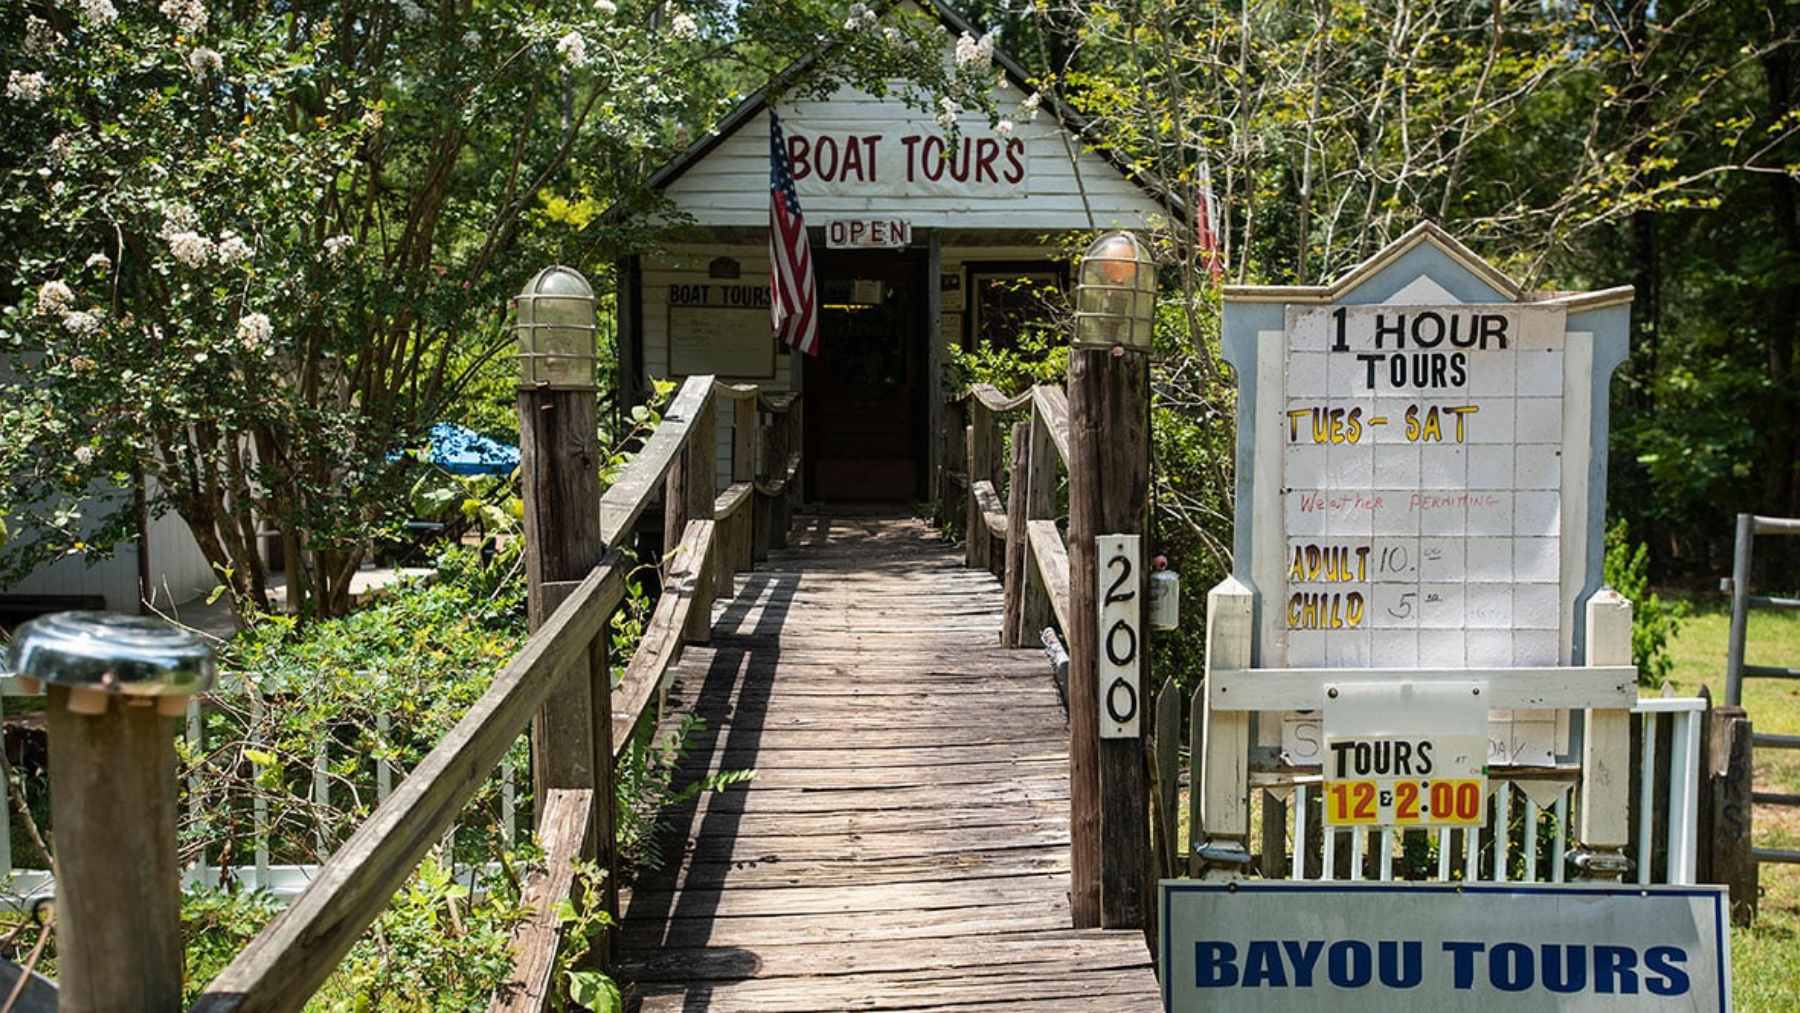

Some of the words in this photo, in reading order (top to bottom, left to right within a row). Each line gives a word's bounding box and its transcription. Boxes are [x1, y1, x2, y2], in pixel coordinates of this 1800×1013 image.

[788, 134, 882, 182] BOAT
[901, 134, 1025, 185] TOURS
[831, 219, 905, 242] OPEN
[670, 284, 710, 304] BOAT
[1331, 307, 1350, 352] 1
[1375, 311, 1509, 350] HOUR
[1357, 352, 1466, 389] TOURS
[1405, 404, 1480, 444] SAT
[1288, 543, 1370, 583] ADULT
[1287, 591, 1365, 629] CHILD
[1104, 554, 1137, 724] 200
[1331, 741, 1433, 778] TOURS
[1331, 782, 1377, 820] 12
[1395, 780, 1480, 820] 2:00
[1195, 940, 1422, 988] BAYOU
[1442, 941, 1690, 995] TOURS
